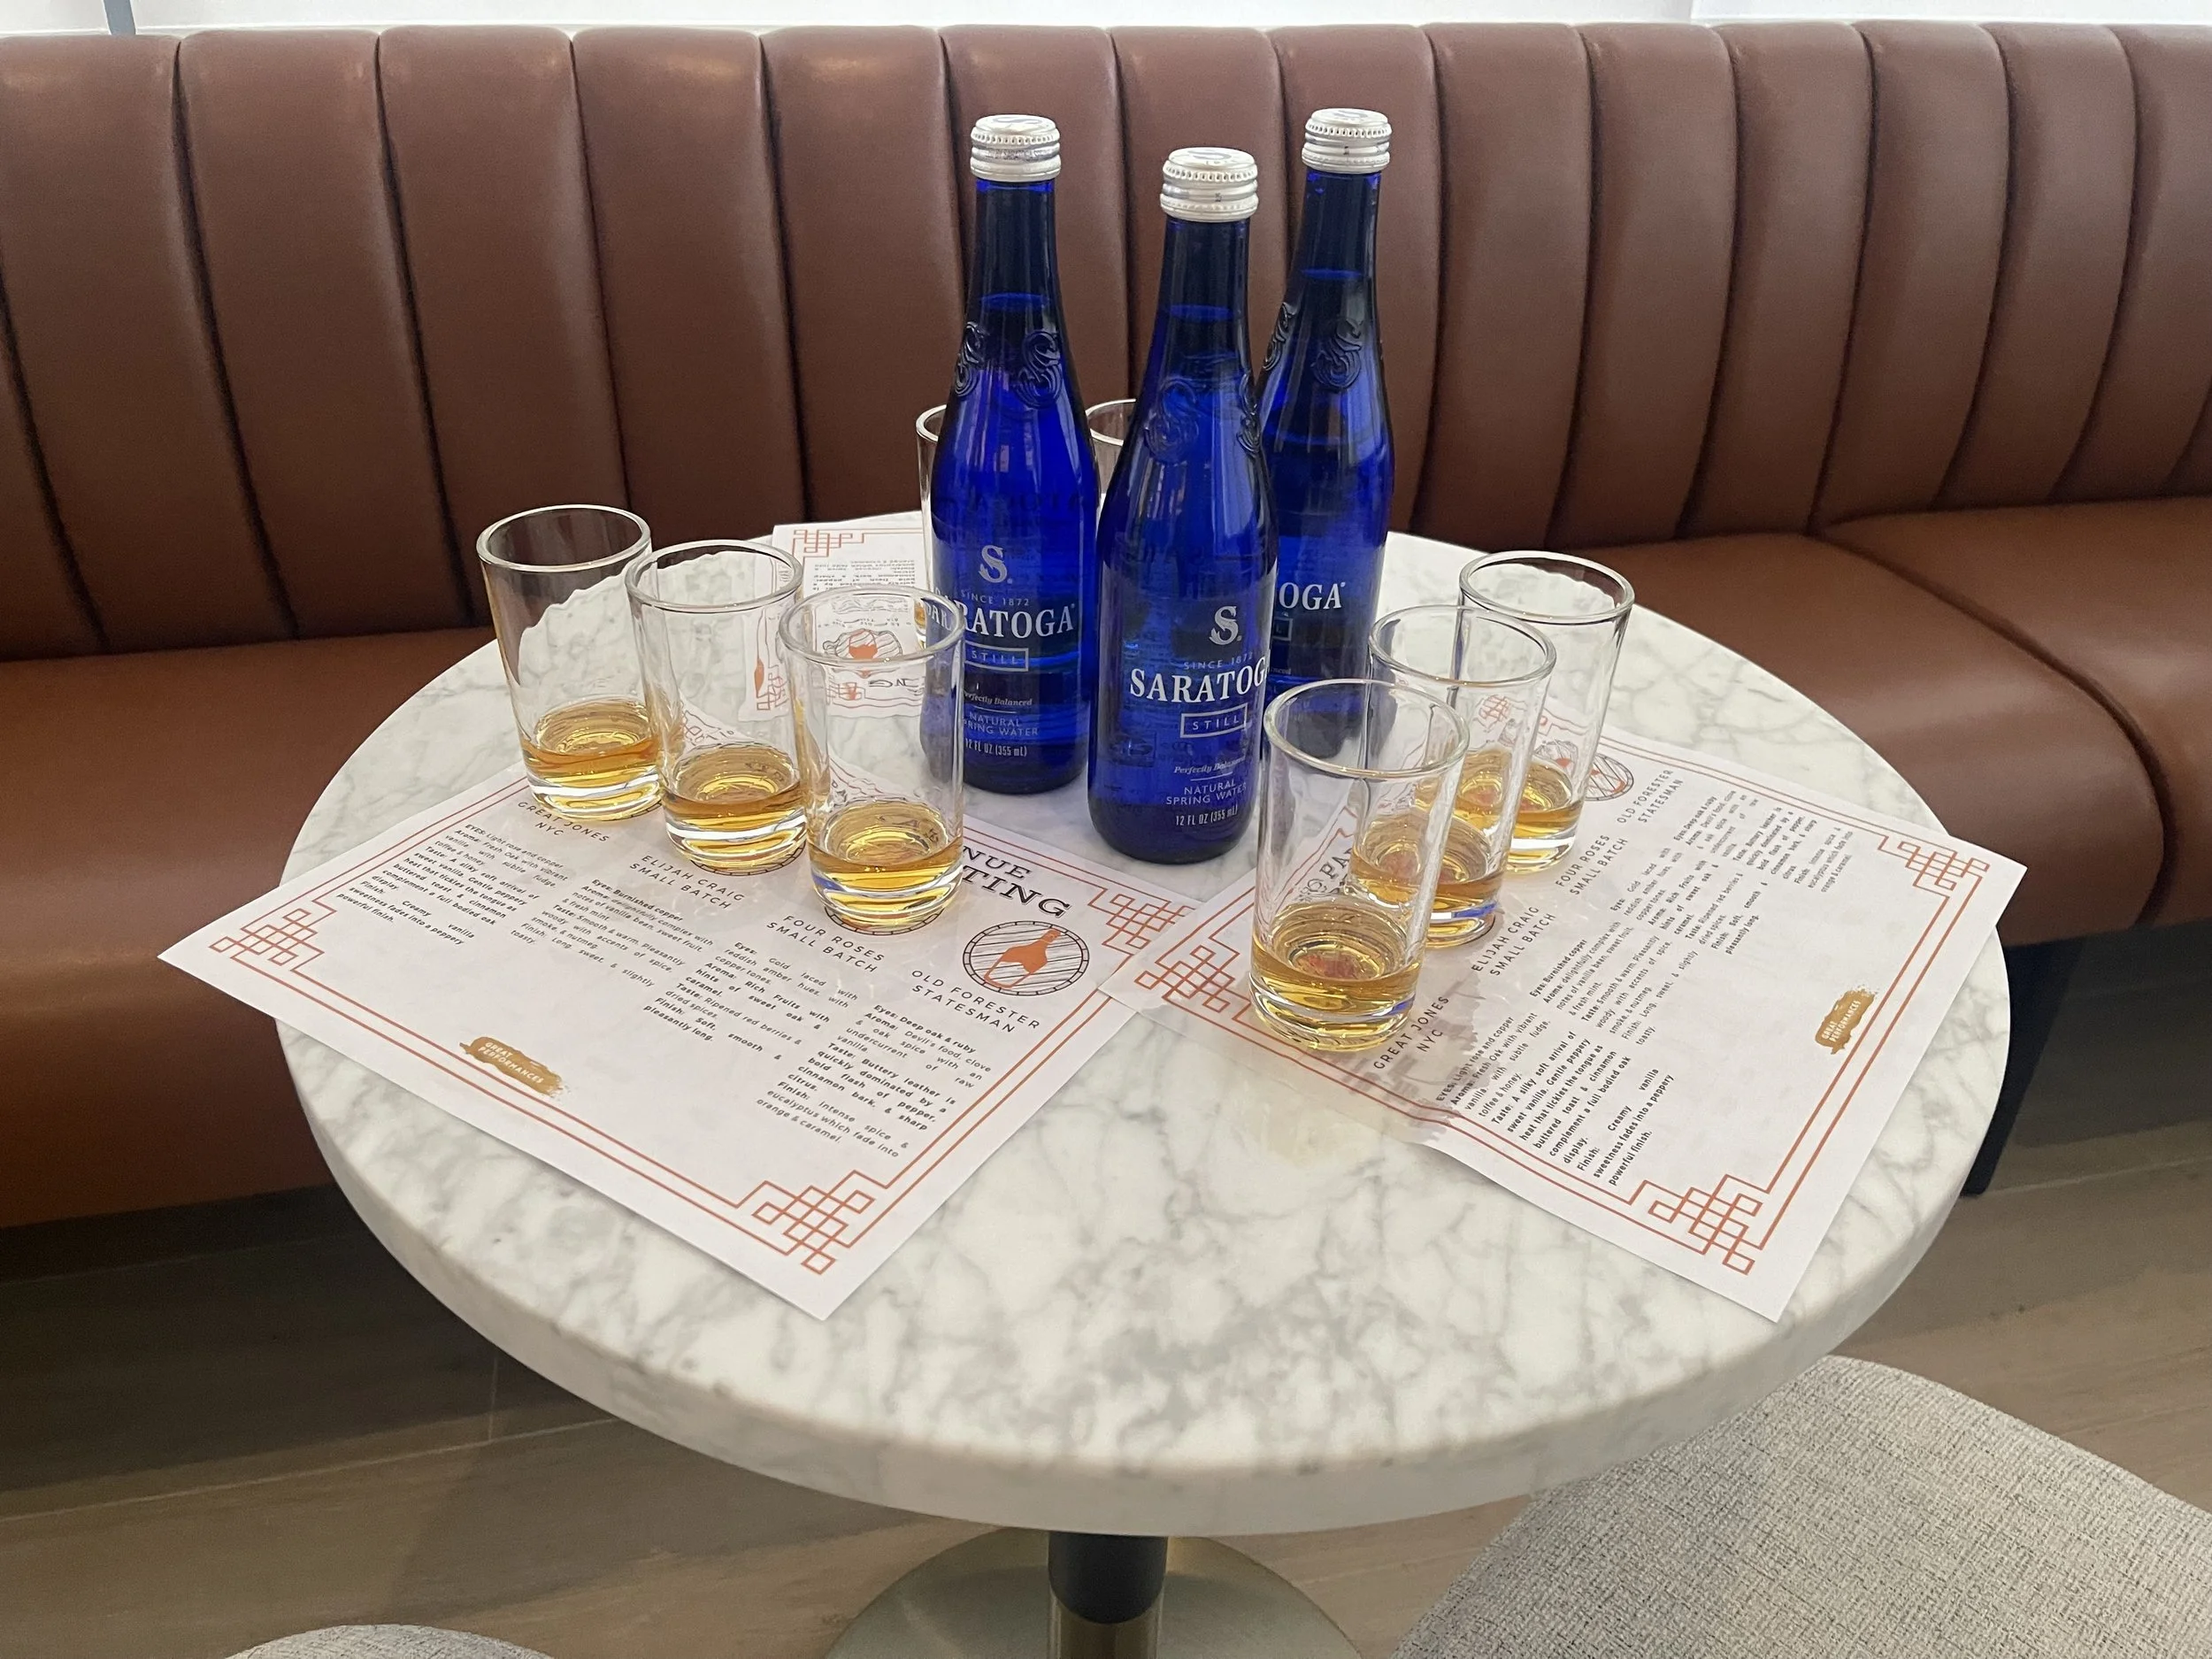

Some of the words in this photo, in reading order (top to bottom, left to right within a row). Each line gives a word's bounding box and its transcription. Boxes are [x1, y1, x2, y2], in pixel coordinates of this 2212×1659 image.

[961, 589, 994, 605] SINCE
[1002, 597, 1030, 606] 1872
[972, 649, 1019, 664] STILL
[1184, 659, 1223, 671] SINCE
[1129, 656, 1268, 703] SARATOG
[969, 711, 1021, 727] NATURAL
[999, 726, 1039, 736] WATER
[1192, 715, 1240, 731] STILL
[974, 740, 981, 752] FL
[984, 742, 993, 754] OZ
[1173, 764, 1212, 775] Perfectly
[1184, 779, 1236, 795] NATURAL
[1166, 795, 1210, 805] SPRING
[1216, 782, 1247, 801] WATER
[1617, 807, 1636, 824] OLD
[1632, 769, 1674, 807] FORESTER
[1638, 779, 1684, 823] STATESMAN
[518, 802, 562, 822] GREAT
[564, 821, 610, 842] JONES
[534, 822, 564, 836] NYC
[1176, 815, 1185, 826] 12
[1187, 814, 1196, 826] FL
[1199, 813, 1209, 825] OZ
[1210, 809, 1225, 823] (355
[641, 855, 694, 879] ELIJAH
[697, 879, 745, 901] CRAIG
[1555, 864, 1583, 887] FOUR
[1579, 834, 1610, 863] ROSES
[1570, 868, 1601, 895] SMALL
[1597, 838, 1628, 867] BATCH
[630, 862, 676, 886] SMALL
[680, 884, 732, 909] BATCH
[766, 922, 816, 948] SMALL
[823, 946, 878, 972] BATCH
[783, 915, 826, 936] FOUR
[832, 935, 885, 962] ROSES
[1471, 935, 1509, 972] ELIJAH
[1489, 945, 1525, 976] SMALL
[1521, 913, 1556, 943] BATCH
[695, 968, 719, 982] hints
[748, 995, 777, 1010] sweet
[786, 1012, 804, 1022] oak
[769, 957, 791, 970] Gold
[800, 972, 826, 986] laced
[837, 989, 857, 1001] with
[911, 970, 944, 987] OLD
[950, 987, 1041, 1029] FORESTER
[642, 1005, 692, 1031] pleasantly
[744, 980, 765, 993] Rich
[772, 995, 801, 1009] Fruits
[809, 1010, 830, 1023] with
[912, 985, 1016, 1033] STATESMAN
[485, 1041, 513, 1058] GREAT
[899, 1016, 924, 1030] Deep
[925, 1029, 943, 1039] oak
[952, 1041, 976, 1054] ruby
[1373, 1033, 1412, 1069] GREAT
[1410, 996, 1449, 1031] JONES
[1416, 1029, 1443, 1053] NYC
[478, 1046, 544, 1084] PERFORMANCES
[807, 1056, 832, 1071] bold
[840, 1073, 865, 1088] flash
[818, 1051, 855, 1070] quickly
[859, 1071, 914, 1097] dominated
[918, 1097, 933, 1107] by
[861, 1058, 899, 1079] Buttery
[903, 1078, 941, 1097] leather
[964, 1058, 991, 1072] clove
[1519, 1078, 1537, 1094] silky
[1535, 1063, 1550, 1076] soft
[1548, 1041, 1569, 1061] arrival
[1567, 1031, 1578, 1040] of
[797, 1066, 845, 1091] cinnamon
[898, 1115, 927, 1130] sharp
[1507, 1111, 1527, 1133] sweet
[1546, 1064, 1567, 1085] Gentle
[1566, 1038, 1591, 1064] peppery
[1518, 1124, 1538, 1141] heat
[1532, 1109, 1549, 1124] that
[1545, 1087, 1571, 1110] tickles
[1563, 1075, 1578, 1087] the
[1574, 1053, 1596, 1075] tongue
[1530, 1118, 1562, 1148] buttered
[1562, 1095, 1580, 1114] toast
[1588, 1051, 1617, 1081] cinnamon
[1548, 1114, 1586, 1156] complement
[1586, 1093, 1602, 1107] full
[1597, 1069, 1620, 1093] bodied
[1617, 1056, 1632, 1069] oak
[1607, 1105, 1632, 1131] Creamy
[1638, 1069, 1659, 1090] vanilla
[767, 1090, 819, 1118] eucalyptus
[820, 1116, 850, 1133] which
[853, 1132, 876, 1145] fade
[877, 1143, 899, 1157] into
[1593, 1141, 1624, 1178] sweetness
[1617, 1121, 1639, 1141] fades
[1632, 1107, 1648, 1122] into
[1649, 1074, 1676, 1102] peppery
[1608, 1151, 1635, 1187] powerful
